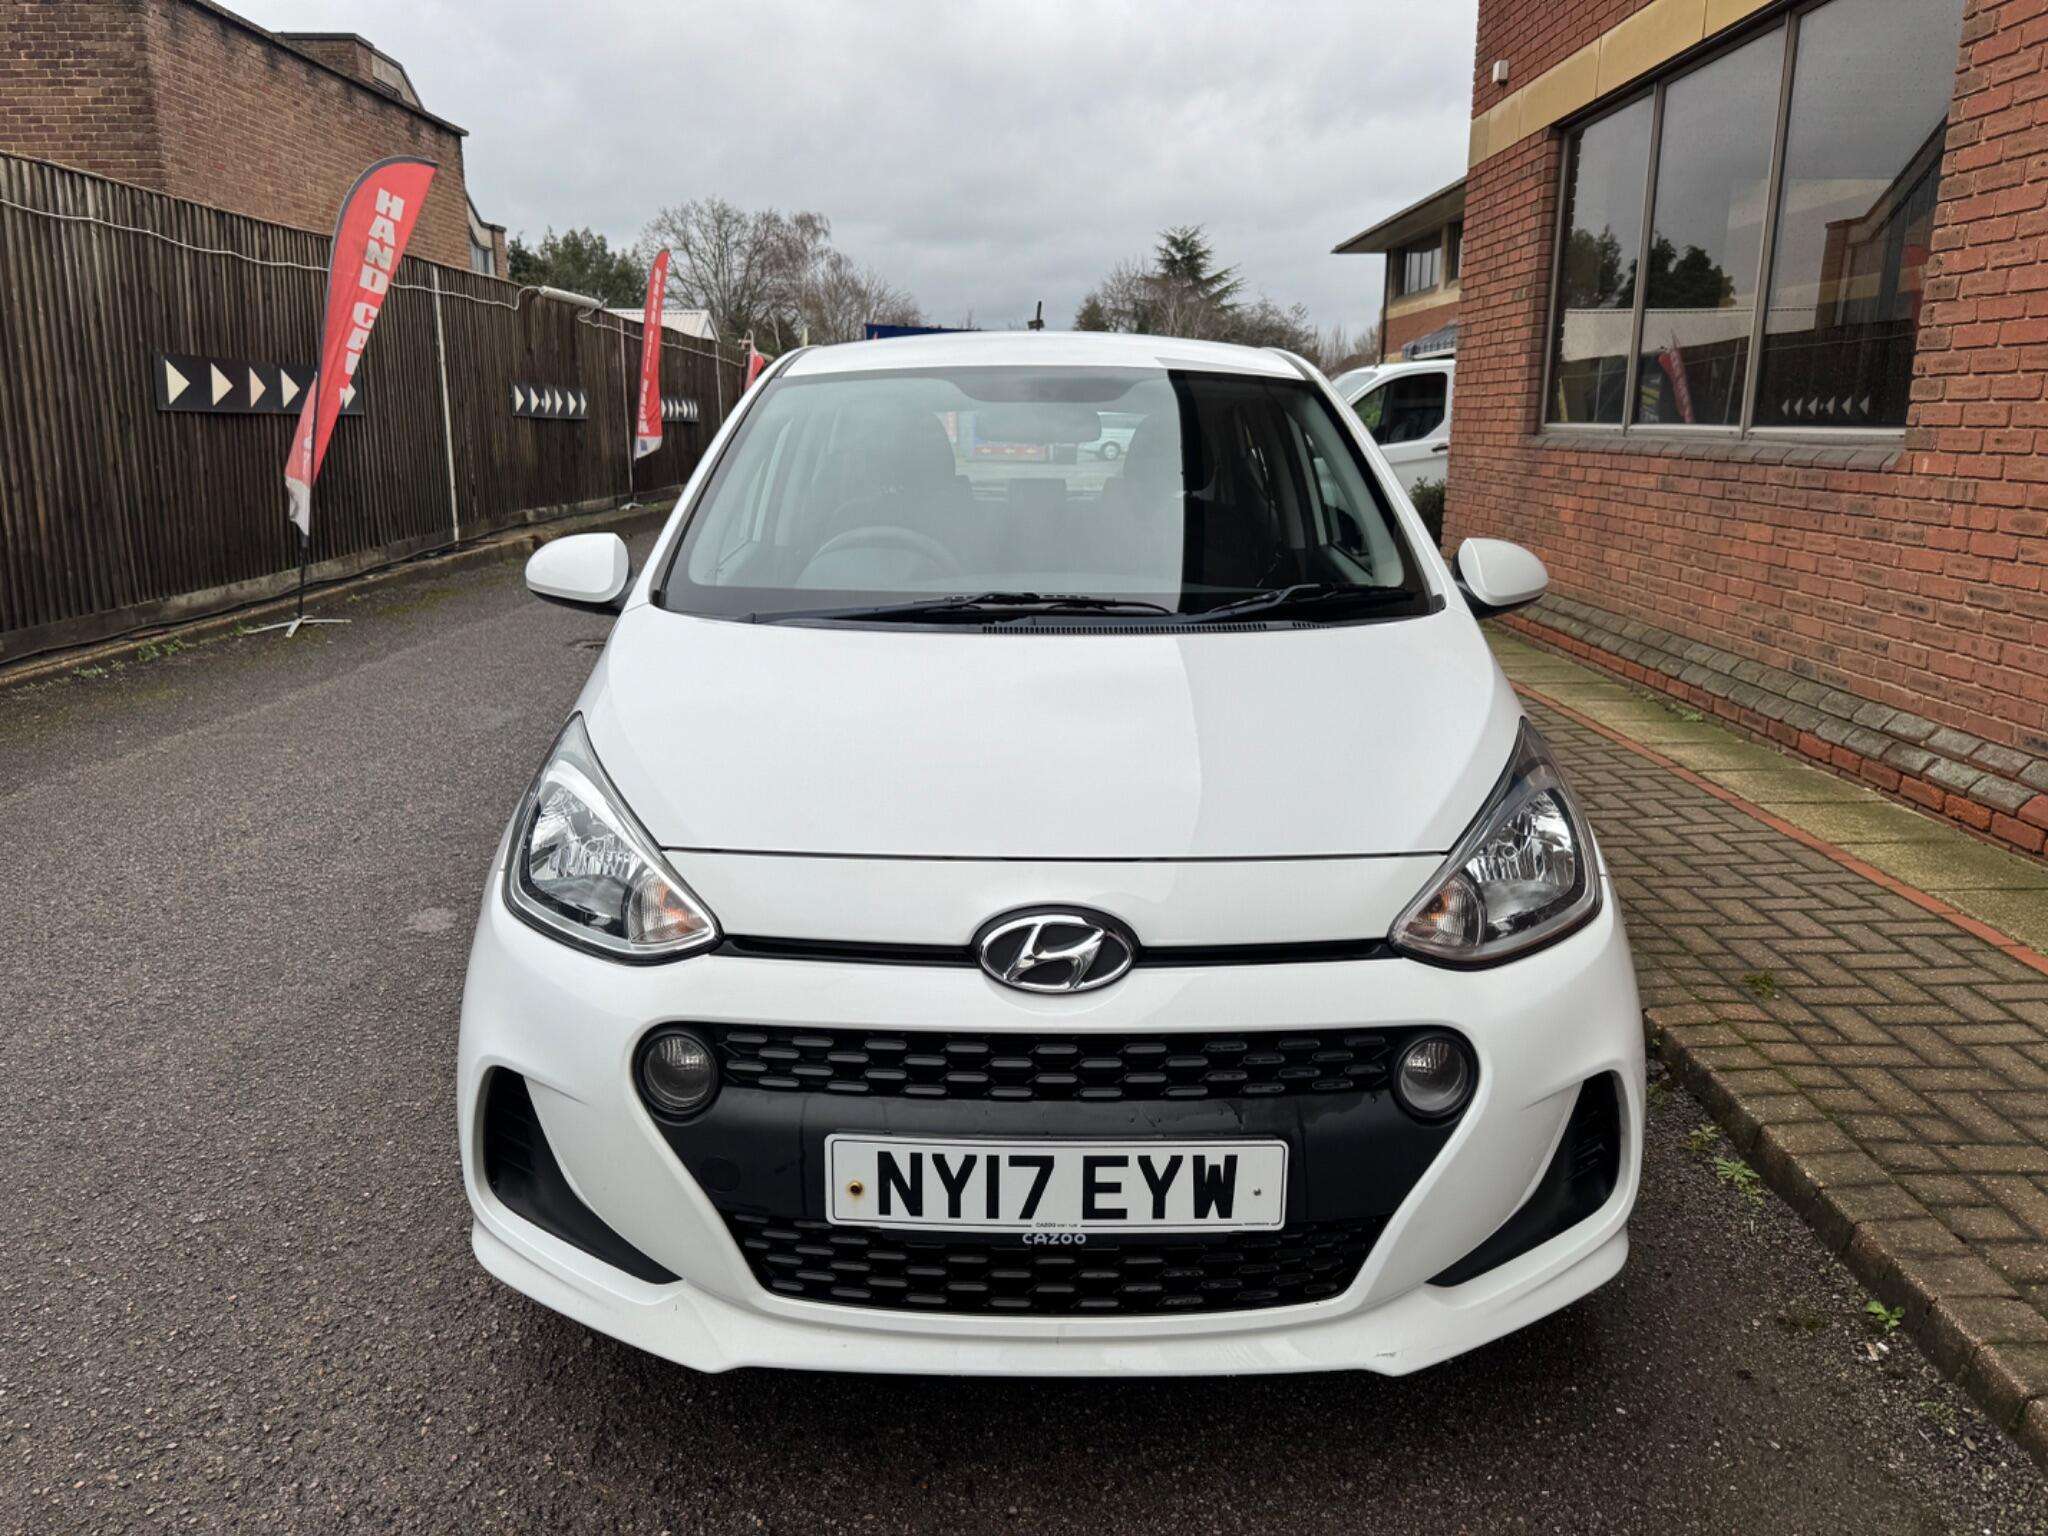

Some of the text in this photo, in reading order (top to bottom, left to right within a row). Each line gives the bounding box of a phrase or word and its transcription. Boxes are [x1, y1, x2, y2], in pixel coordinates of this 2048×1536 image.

[359, 187, 405, 295] HAND
[877, 1150, 1239, 1220] NY17 EYW
[1022, 1233, 1087, 1245] CAZOO
